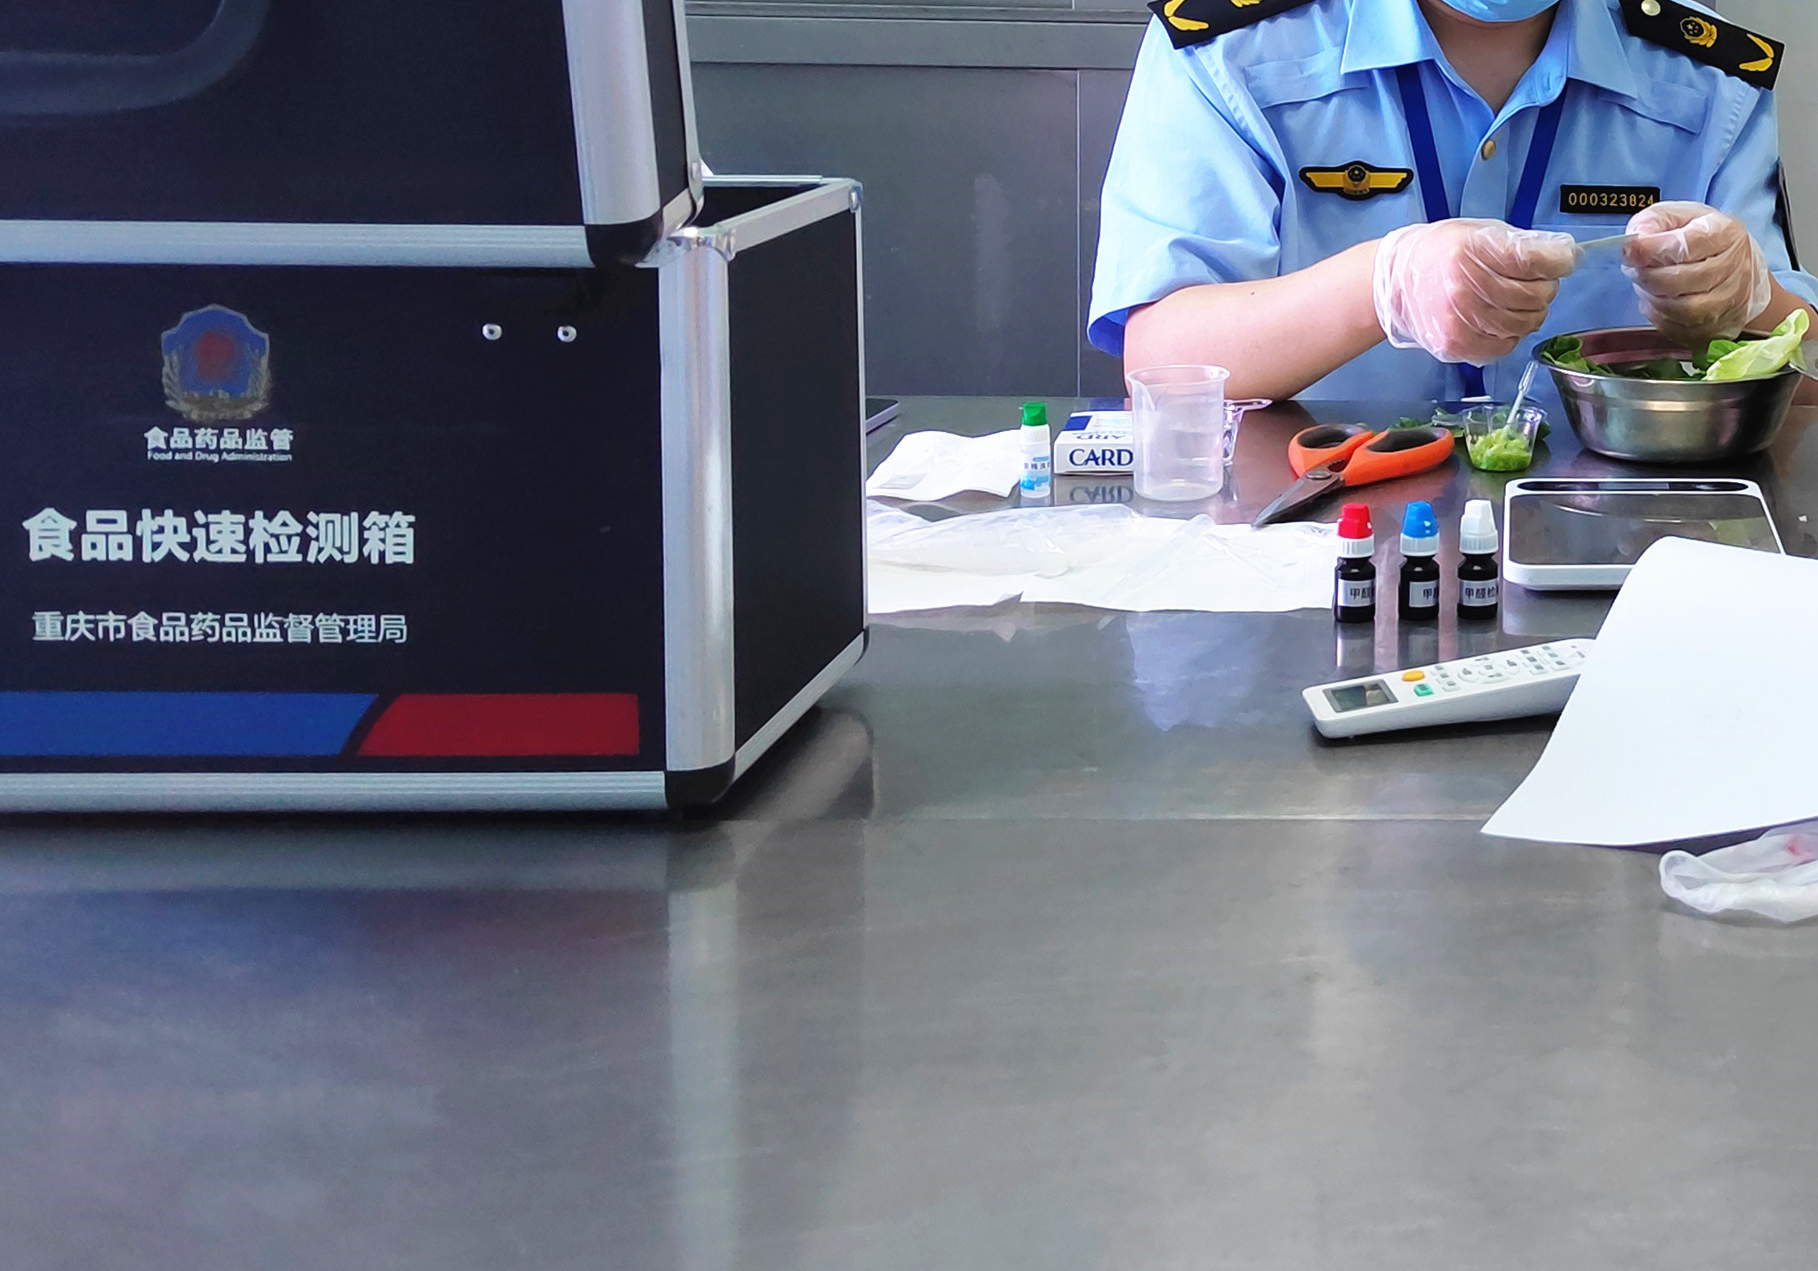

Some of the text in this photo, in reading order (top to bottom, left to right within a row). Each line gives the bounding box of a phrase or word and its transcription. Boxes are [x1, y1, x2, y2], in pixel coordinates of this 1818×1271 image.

[1568, 192, 1654, 207] 000323824
[144, 426, 294, 450] 食品药品监管
[148, 451, 292, 462] Food and Drug Administration
[1069, 448, 1134, 467] CARD
[22, 507, 416, 565] 食品快速检测箱
[32, 610, 408, 644] 重庆市食品药品监督管理局
